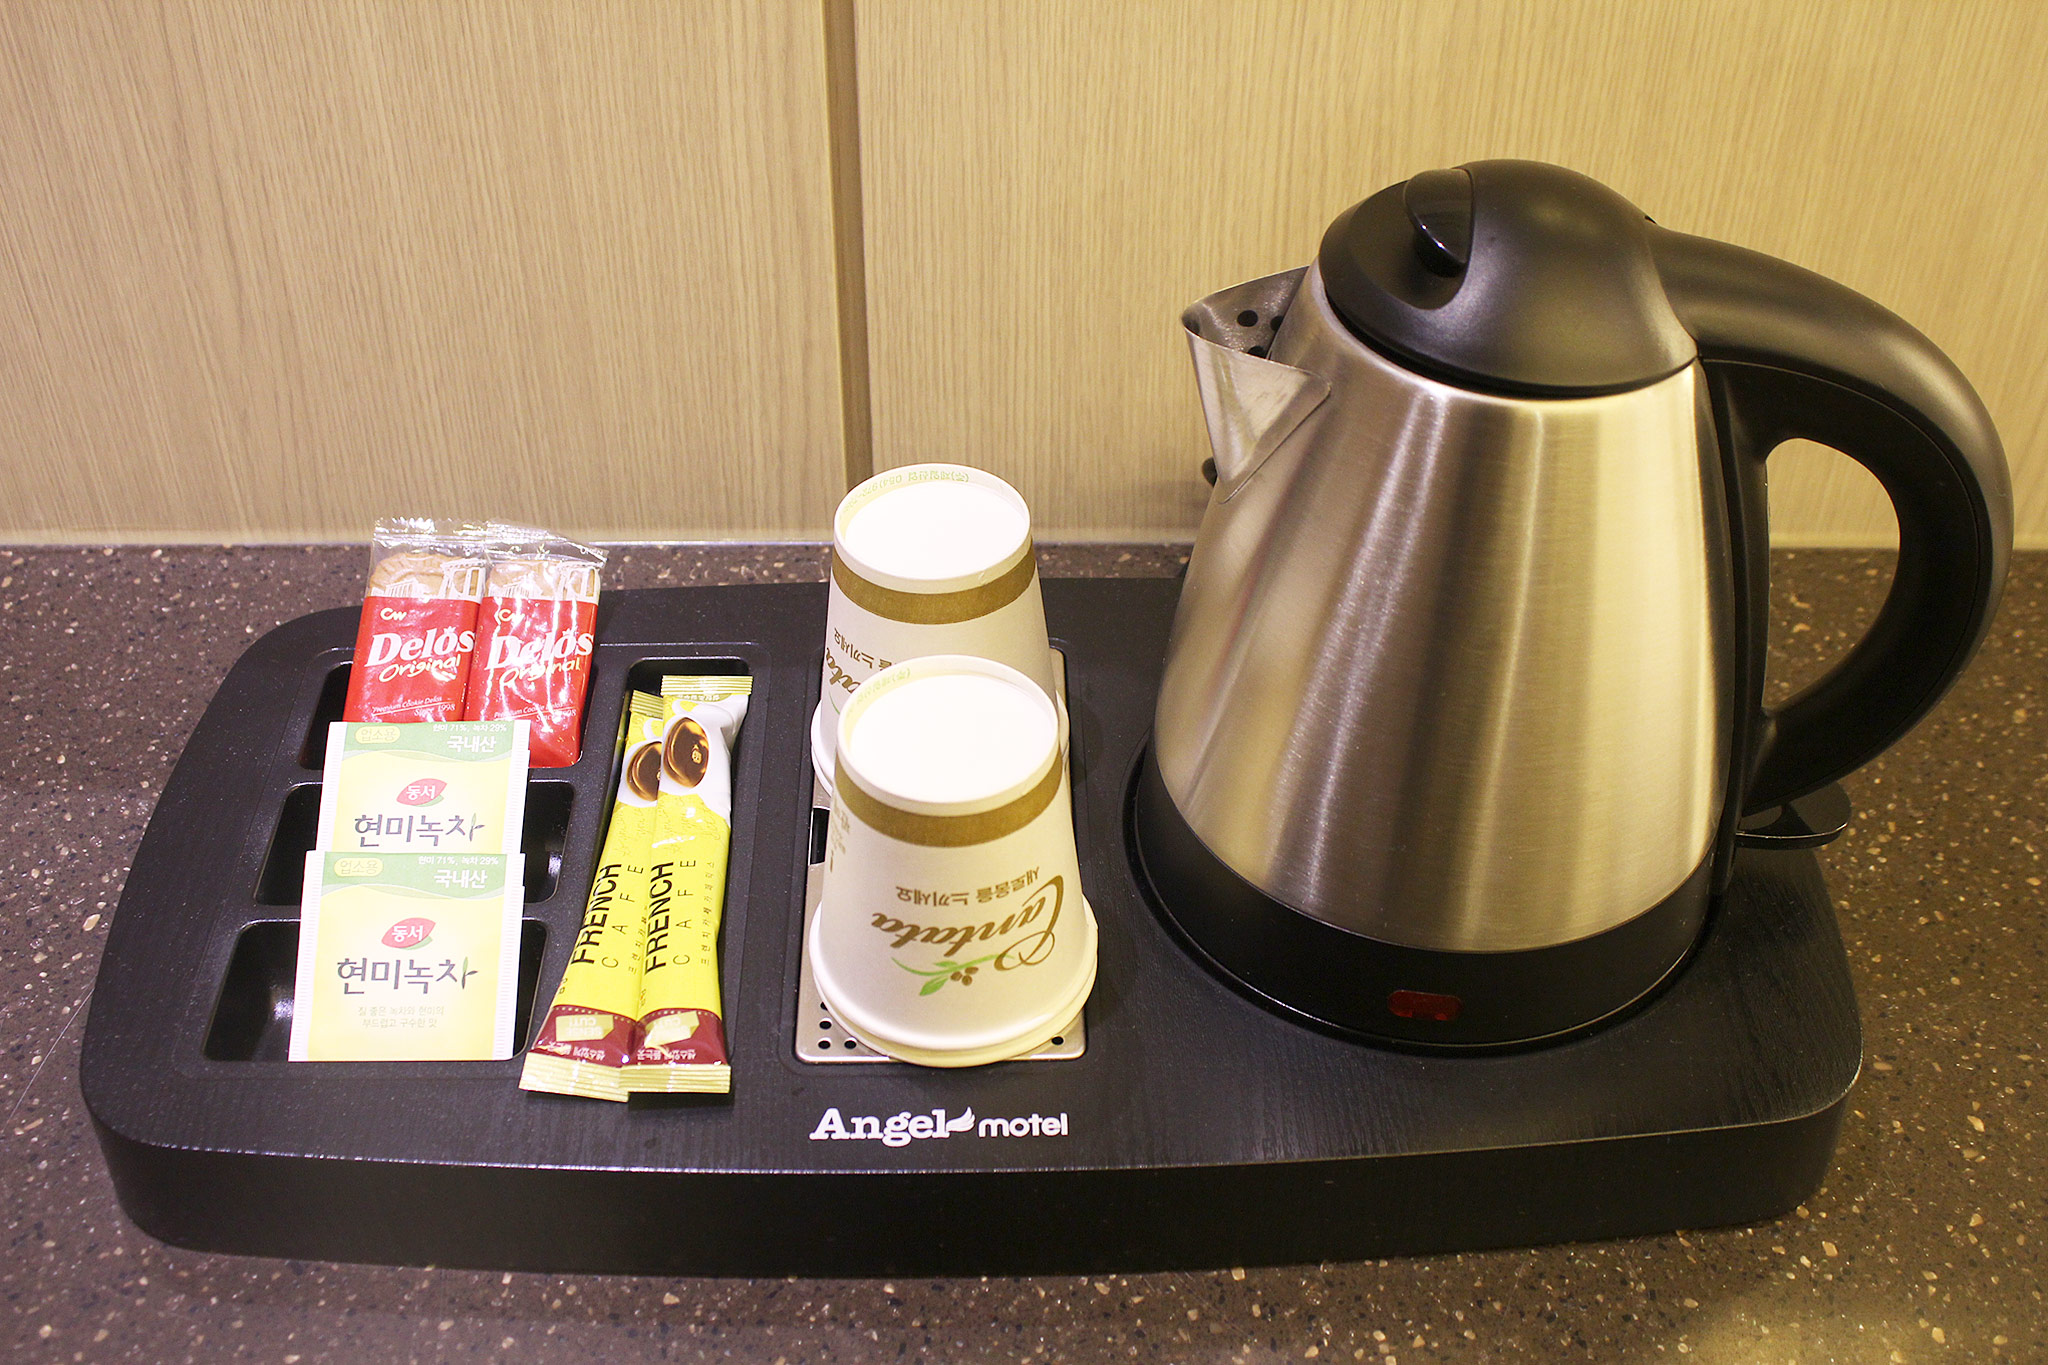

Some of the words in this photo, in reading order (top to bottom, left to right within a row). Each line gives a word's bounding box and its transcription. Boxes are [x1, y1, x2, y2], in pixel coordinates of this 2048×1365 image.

[364, 626, 475, 668] Delos
[484, 628, 594, 670] Delos
[379, 654, 461, 683] Original
[499, 657, 581, 685] Orgnal
[360, 728, 397, 742] 업소용
[446, 735, 496, 753] 국내산
[405, 785, 436, 801] 동서
[354, 813, 486, 848] 현미녹차
[340, 859, 378, 875] 업소용
[433, 869, 488, 889] 국내산
[896, 885, 970, 907] 느끼세요
[975, 866, 1041, 902] 새로움을
[570, 863, 622, 966] FRENCH
[645, 860, 674, 976] FRENCH
[871, 874, 1065, 972] Cantata
[391, 925, 424, 942] 동서
[336, 956, 479, 995] 현미녹차
[808, 1107, 950, 1148] Angel
[978, 1112, 1069, 1138] motel
